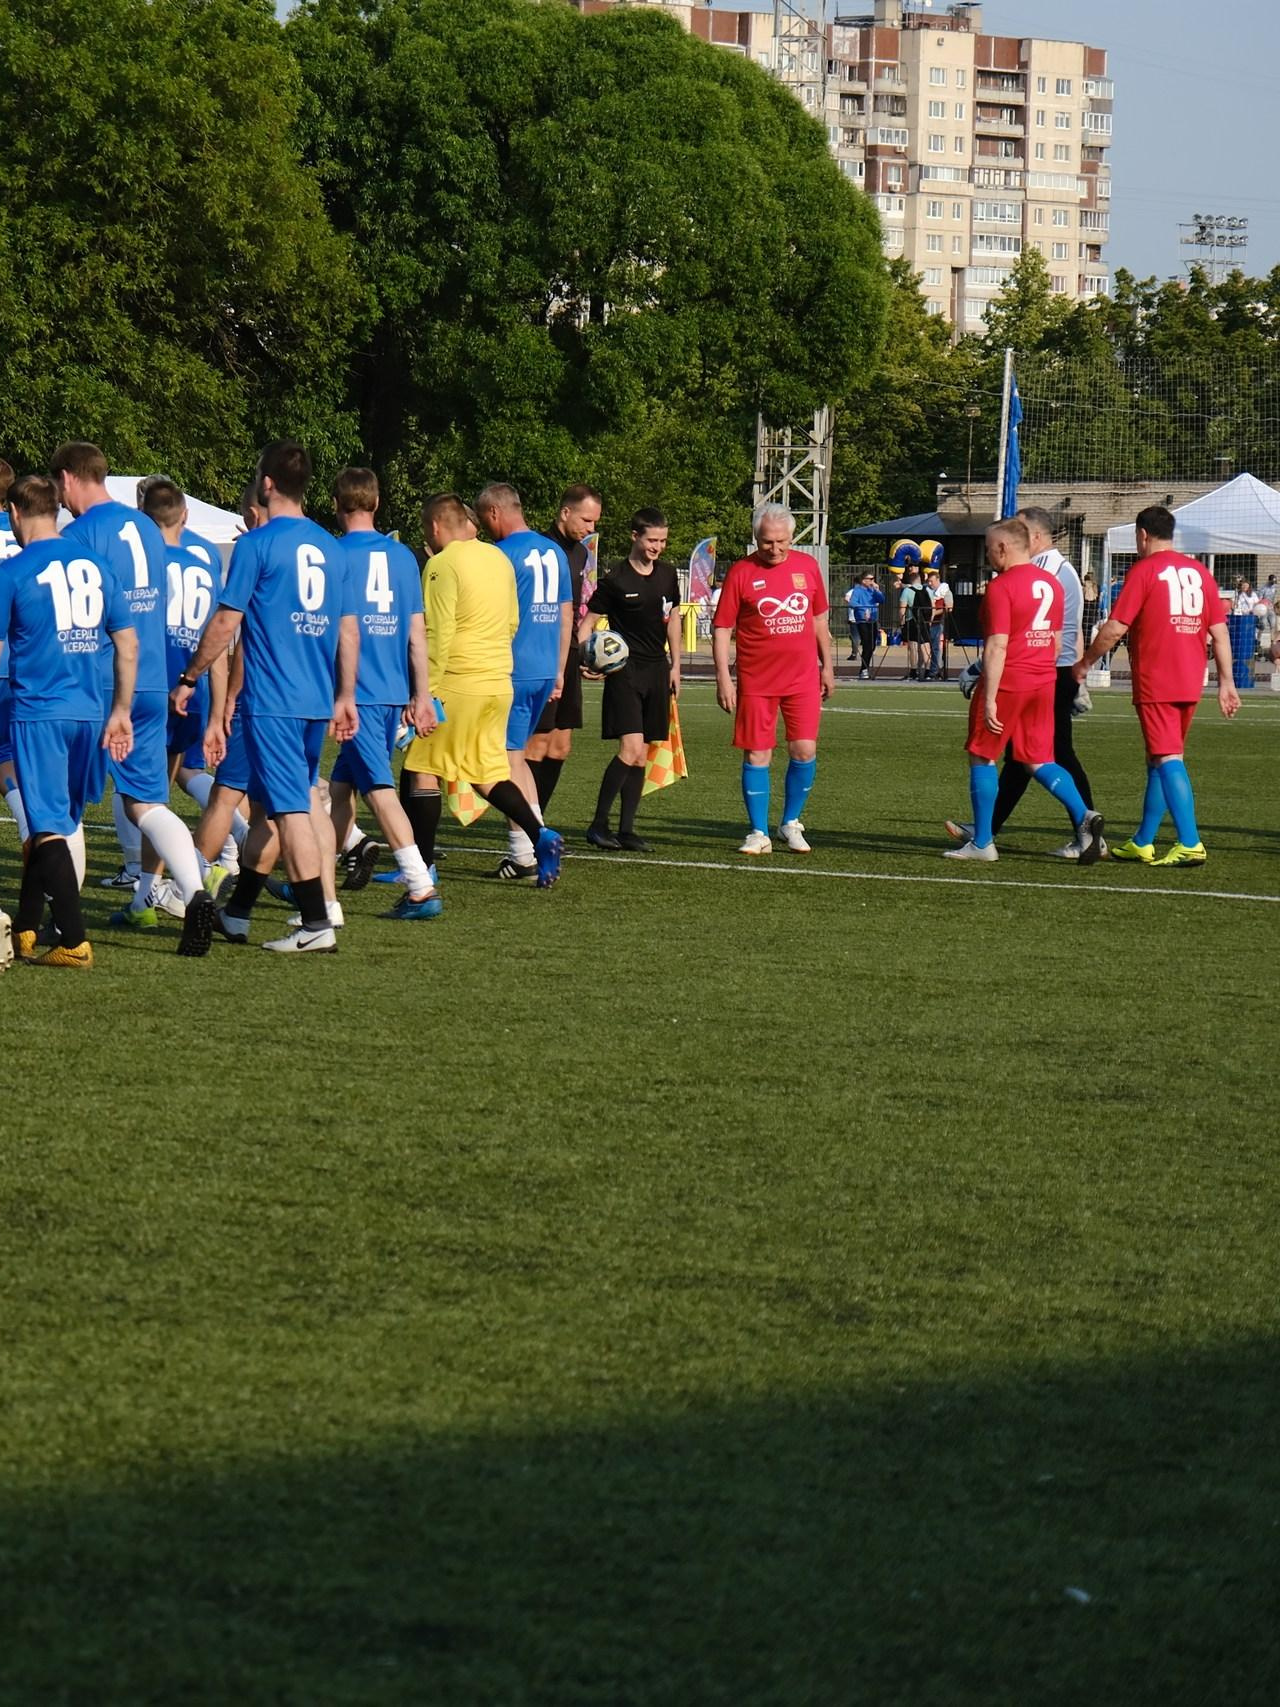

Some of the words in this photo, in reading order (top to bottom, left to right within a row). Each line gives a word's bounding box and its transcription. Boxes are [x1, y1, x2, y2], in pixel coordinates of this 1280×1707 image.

[118, 520, 149, 588] 1
[296, 543, 326, 612] 6
[524, 548, 559, 603] 11
[36, 558, 104, 631] 18
[166, 562, 213, 630] 16
[366, 551, 394, 613] 4
[1031, 580, 1055, 631] 2
[1158, 565, 1204, 617] 18
[70, 629, 99, 641] СЕРДЦ
[764, 618, 777, 627] ОТ
[777, 615, 806, 626] СЕРДЦА
[770, 626, 777, 635] К
[776, 624, 805, 634] СЕРДЦУ
